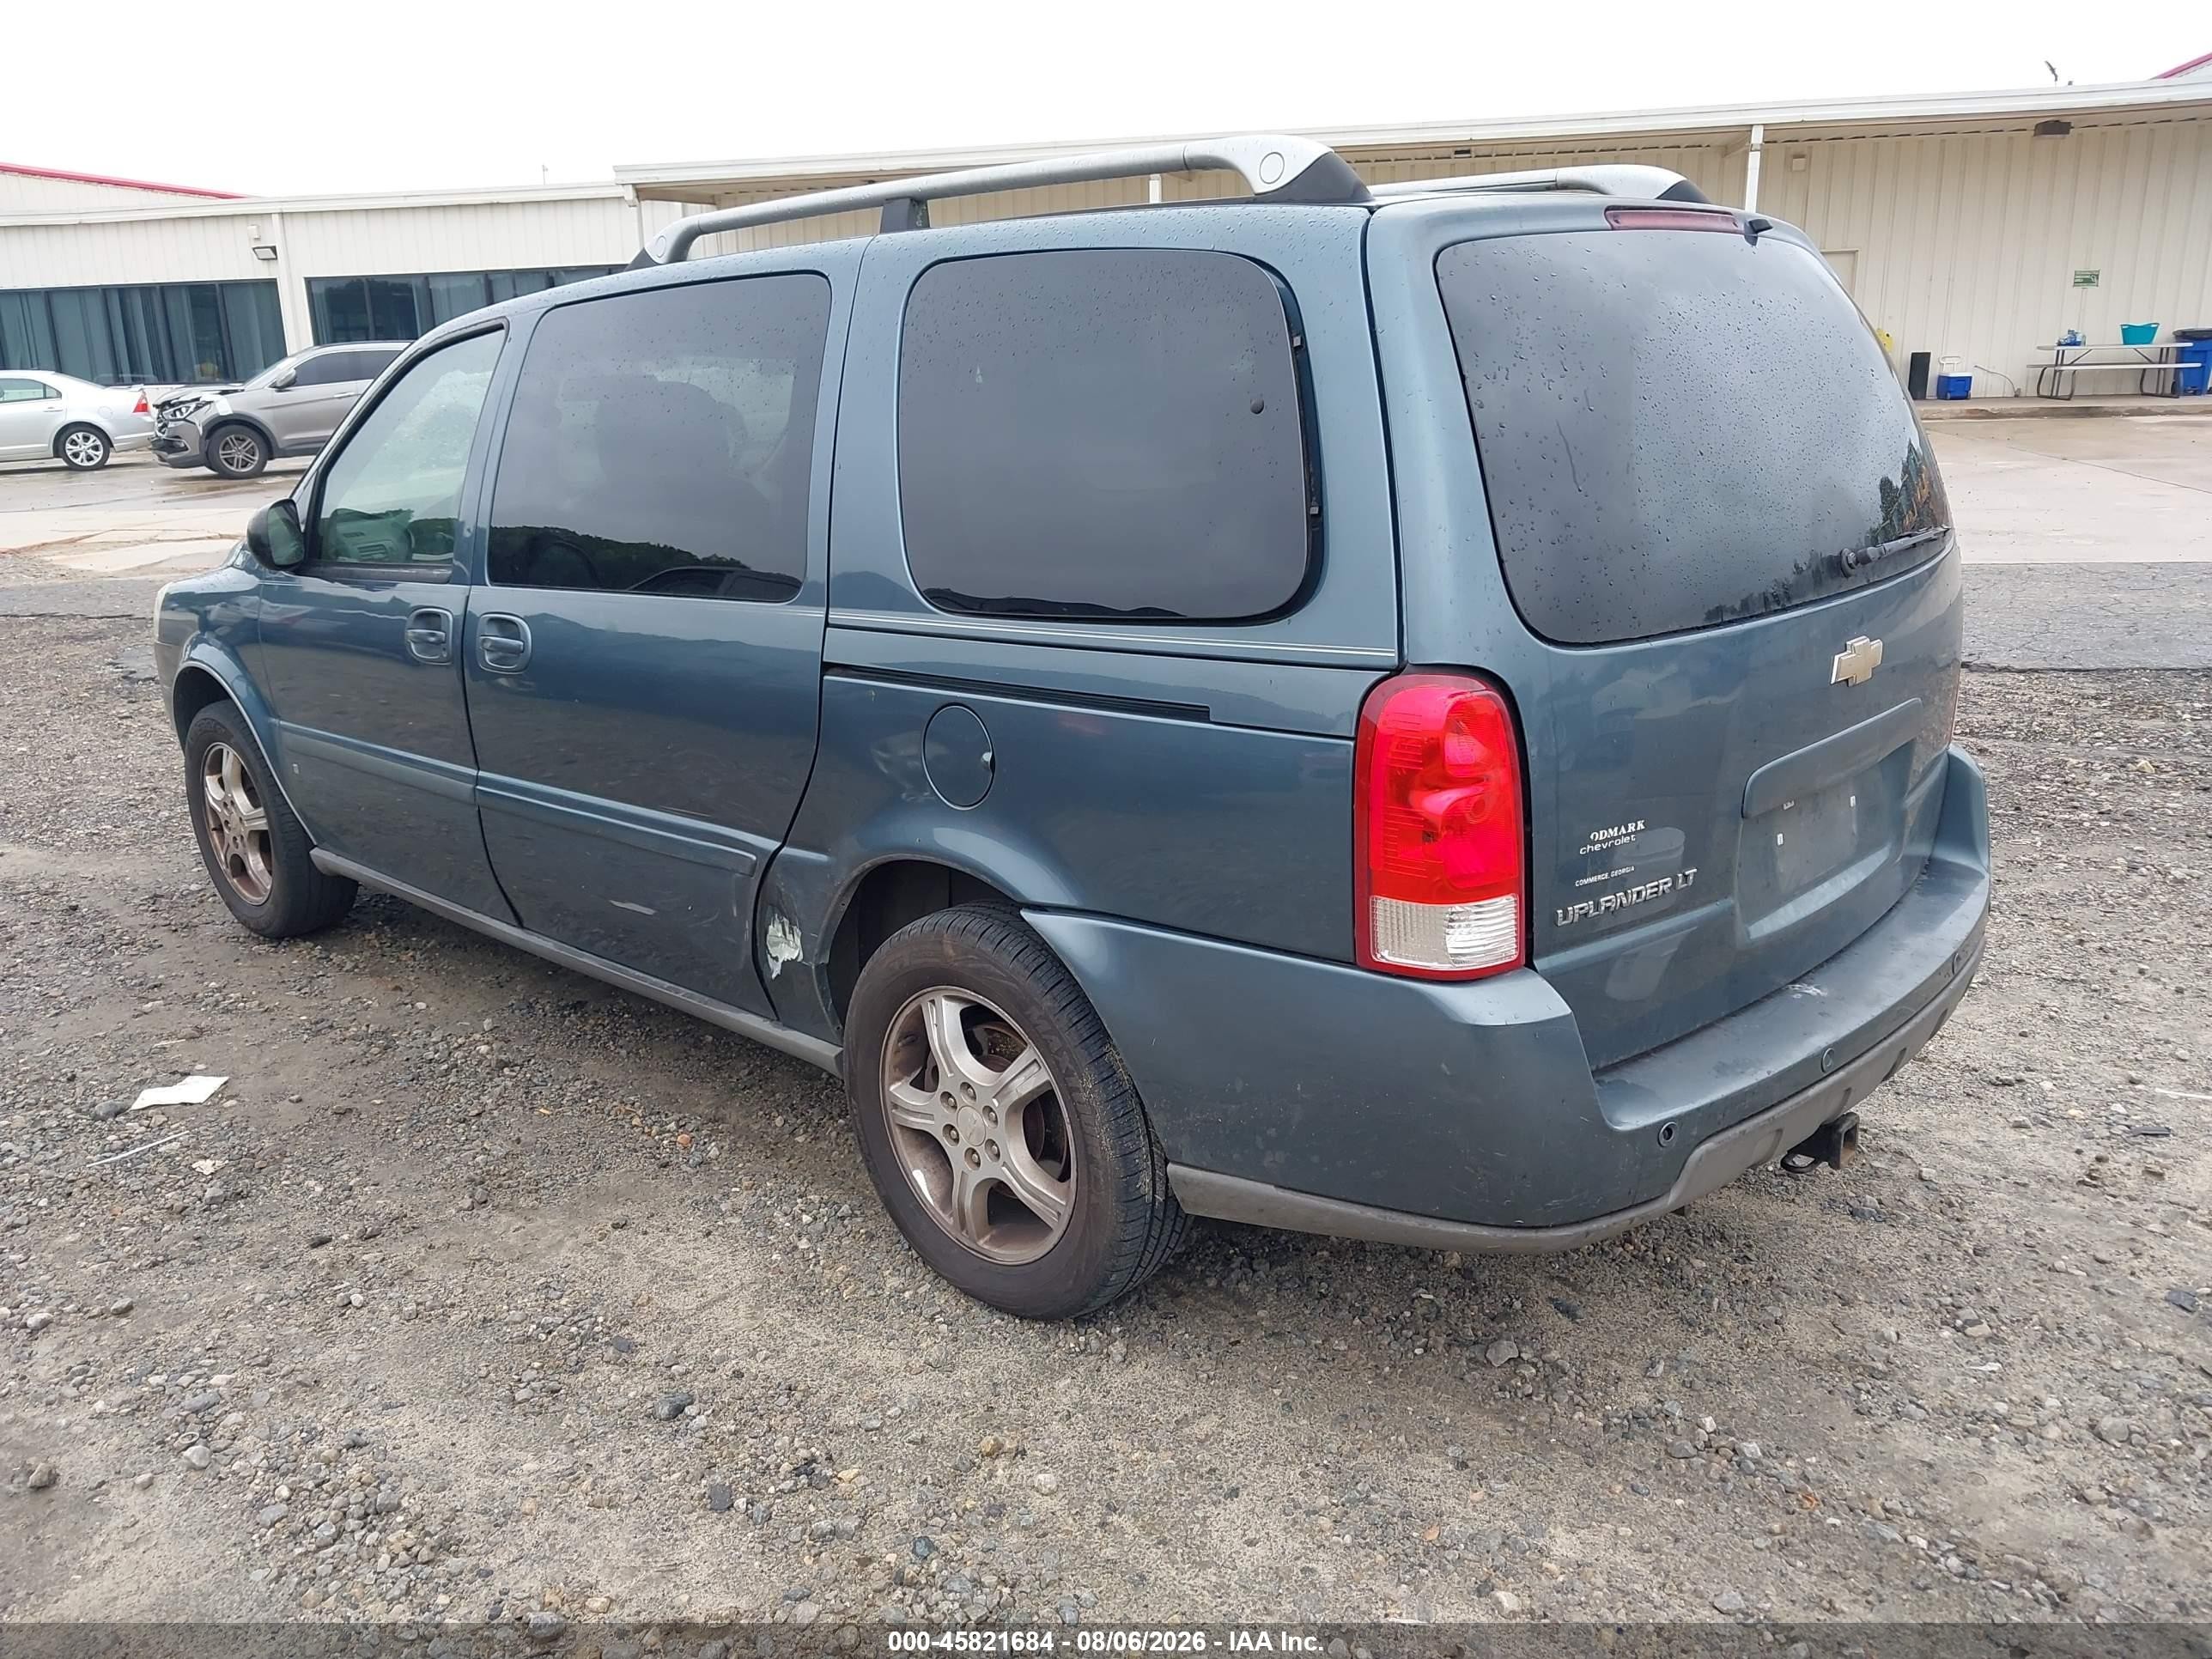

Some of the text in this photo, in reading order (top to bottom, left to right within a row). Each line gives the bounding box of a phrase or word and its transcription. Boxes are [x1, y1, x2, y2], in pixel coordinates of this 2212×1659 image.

[1579, 834, 1636, 855] chevrolet
[1610, 866, 1635, 878] GEORGIA
[1555, 867, 1698, 927] UPLANDER LT
